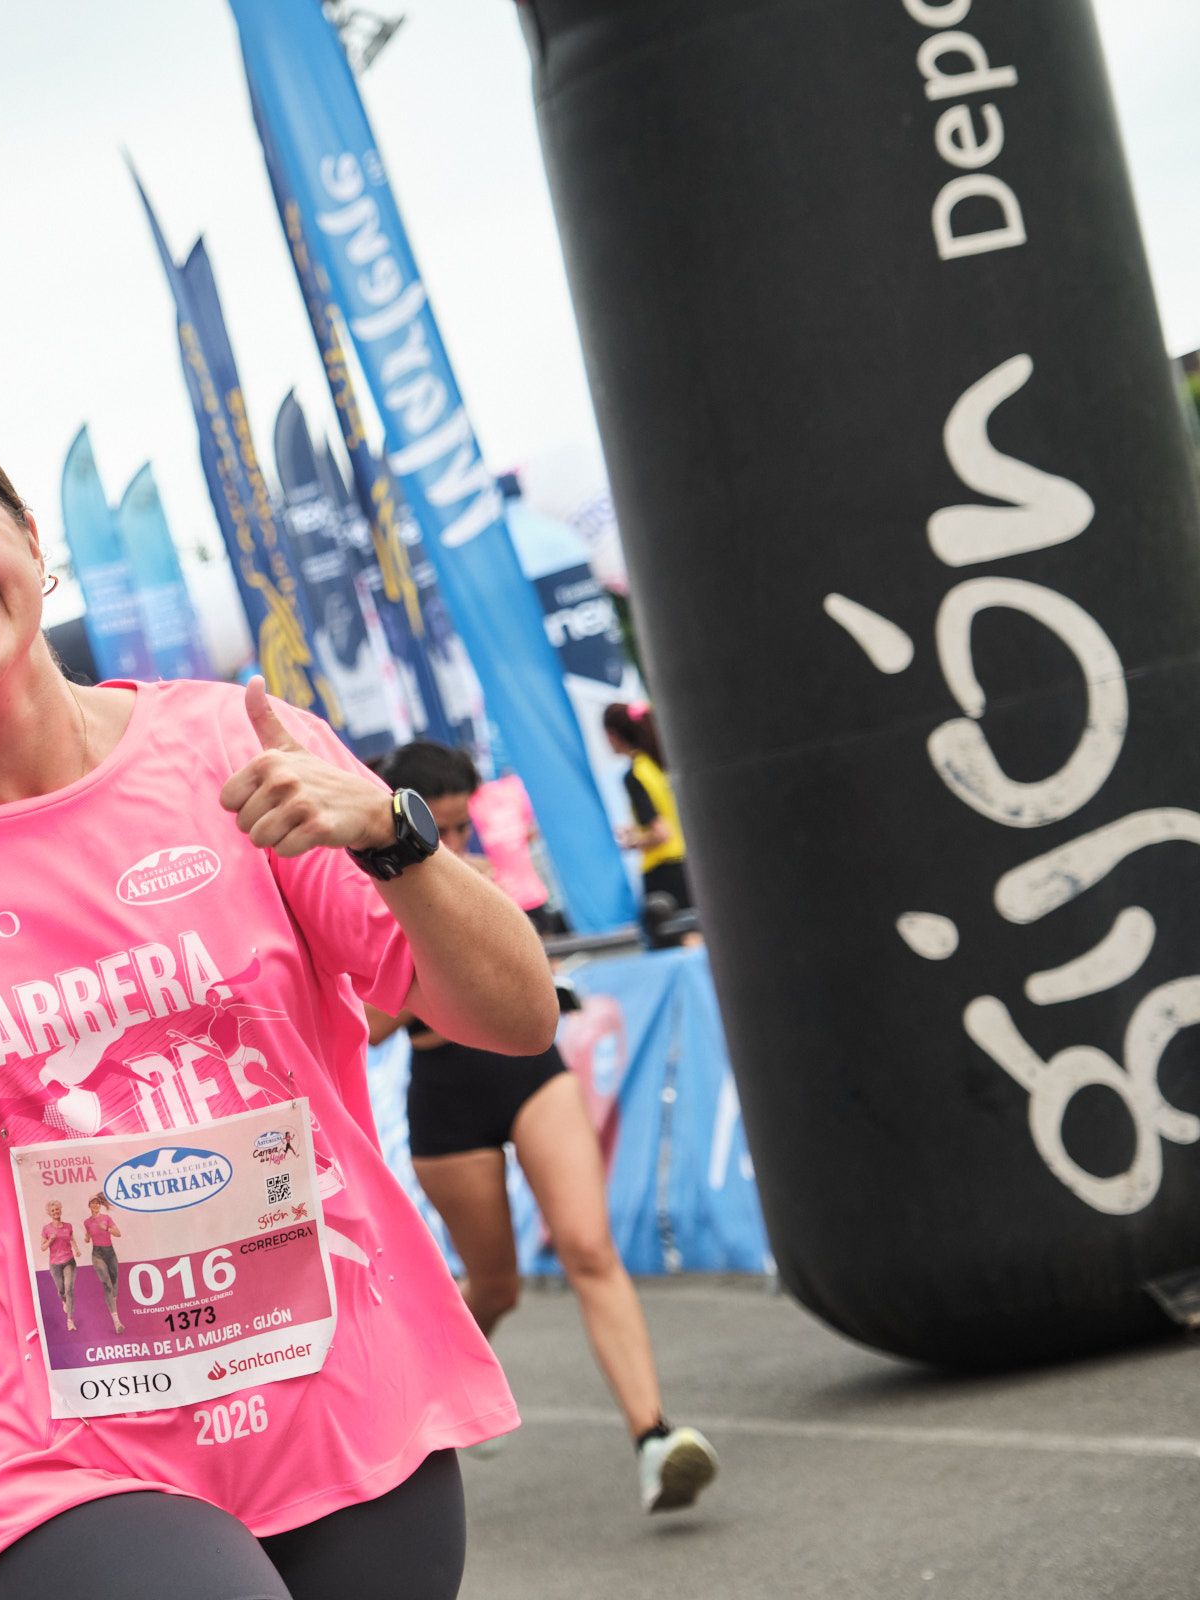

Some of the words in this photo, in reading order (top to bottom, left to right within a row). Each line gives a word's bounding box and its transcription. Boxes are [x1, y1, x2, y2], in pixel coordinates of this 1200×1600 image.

[36, 1159, 50, 1170] TU
[54, 1156, 94, 1169] DORSAL
[130, 1168, 173, 1181] CENTRAL
[176, 1159, 218, 1174] LECHERA
[42, 1167, 97, 1187] SUMA
[258, 1209, 288, 1230] gijón
[240, 1227, 313, 1255] CORREDORA
[128, 1247, 237, 1306] 016
[165, 1300, 200, 1311] VIOLENCIA
[164, 1306, 217, 1333] 1373
[85, 1342, 150, 1363] CARRERA
[154, 1338, 173, 1356] DE
[176, 1335, 194, 1353] LA
[198, 1322, 242, 1347] MUJER
[253, 1307, 293, 1331] GIJÓN
[228, 1343, 312, 1376] Santander
[80, 1373, 172, 1401] OYSHO
[194, 1394, 269, 1446] 2026
